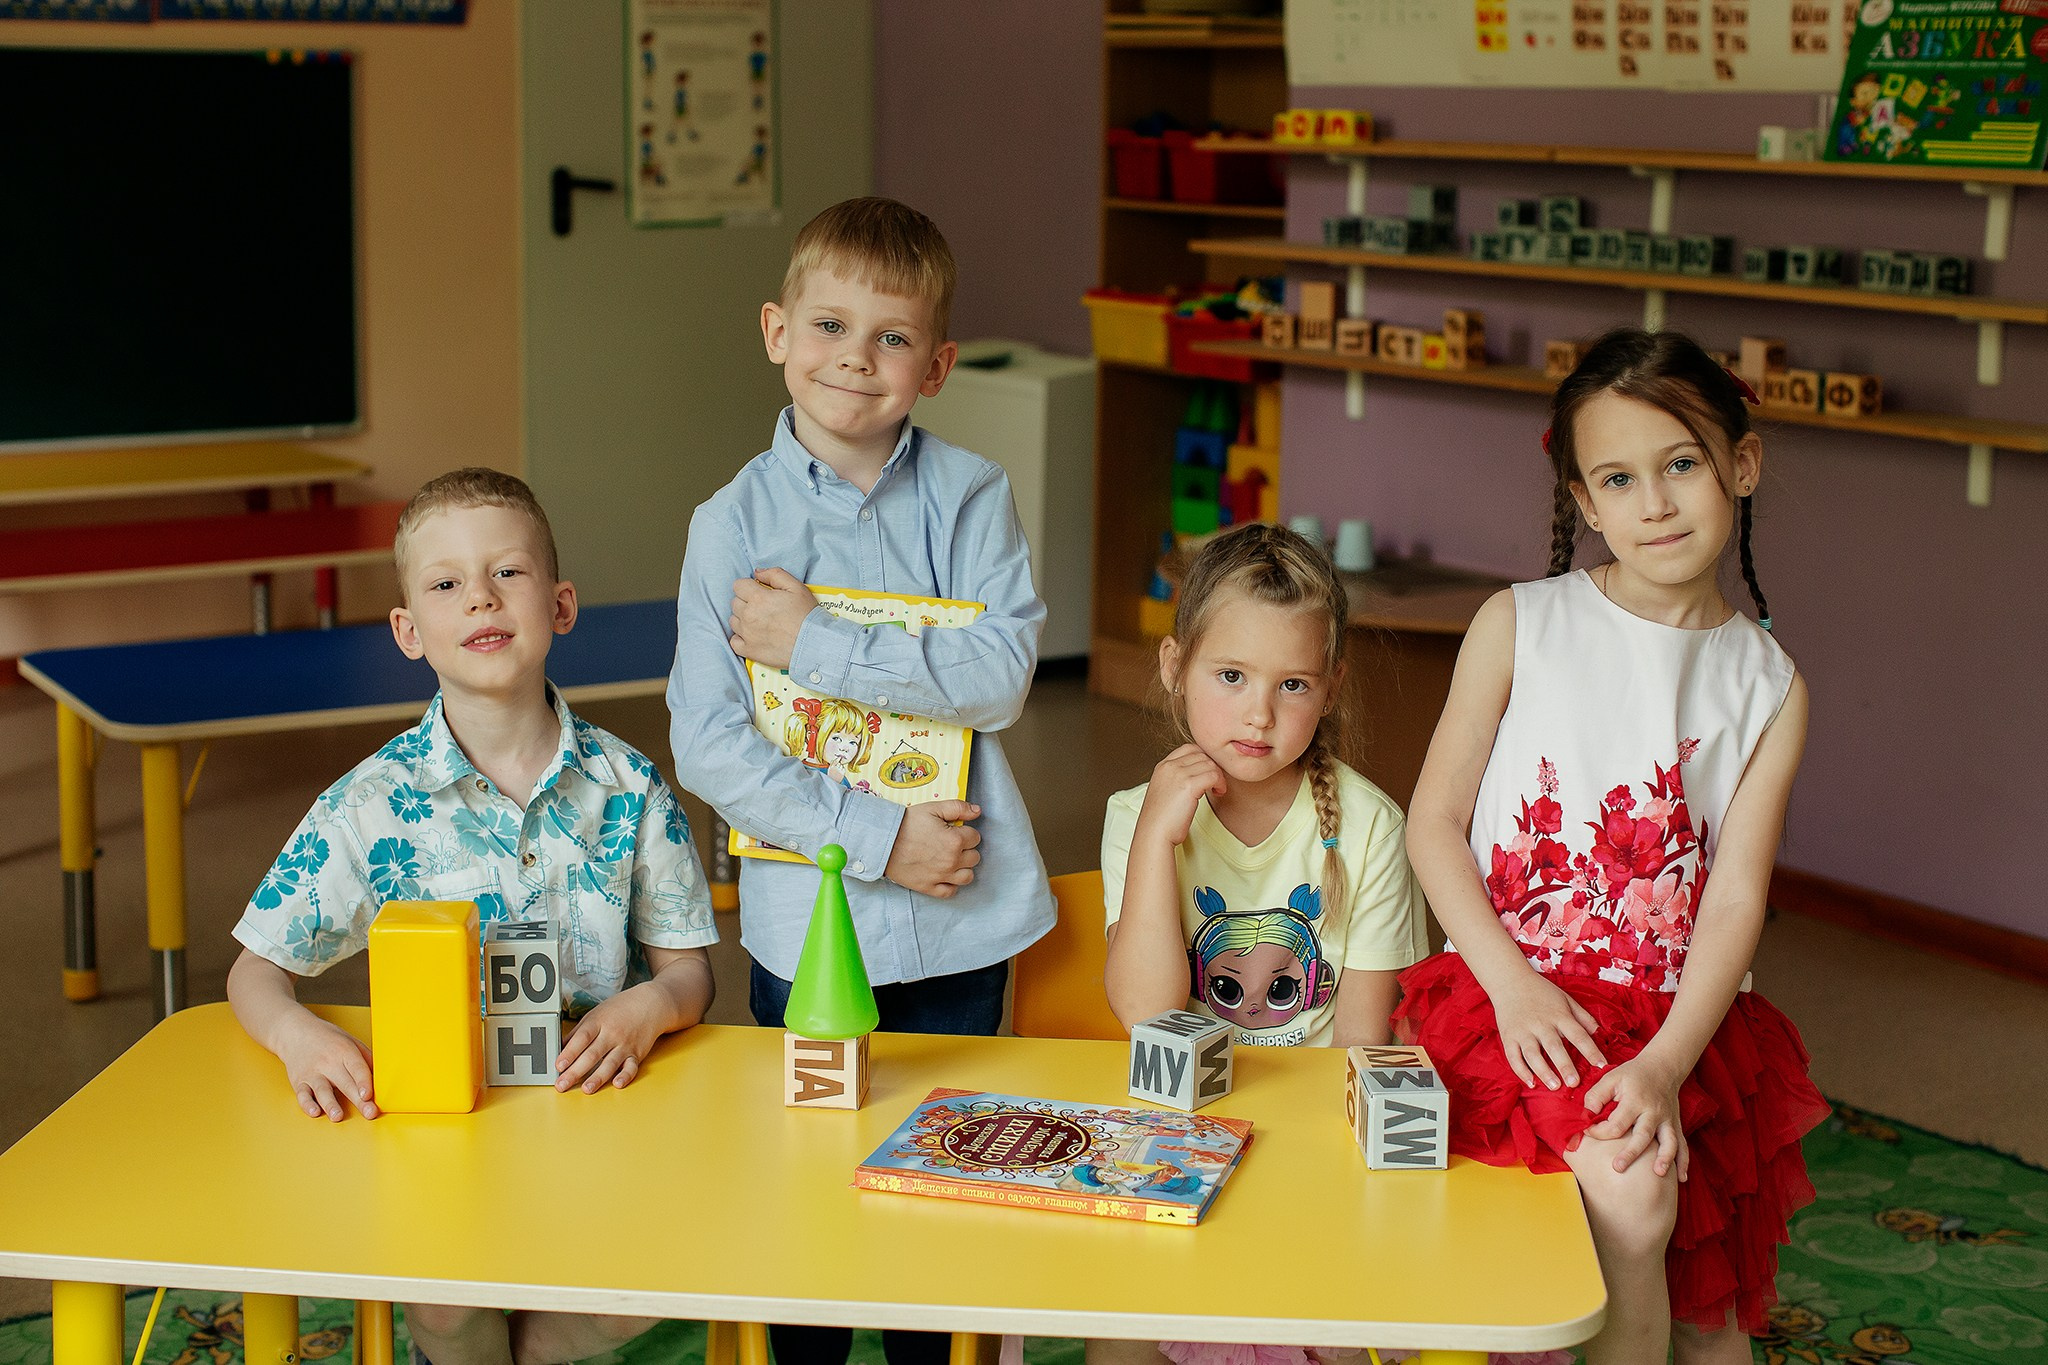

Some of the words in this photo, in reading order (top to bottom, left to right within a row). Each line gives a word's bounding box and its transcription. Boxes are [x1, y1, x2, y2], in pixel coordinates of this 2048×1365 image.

[1889, 15, 2025, 31] МАГНИТНАЯ
[1868, 31, 2027, 59] АЗБУКА
[1828, 385, 1853, 407] Ф
[818, 600, 844, 611] стрид
[844, 603, 885, 618] Линдгрен
[496, 921, 548, 940] БА
[491, 952, 556, 1004] БО
[1147, 1013, 1217, 1037] МО
[1241, 1027, 1306, 1047] SURPRISE!
[498, 1027, 547, 1075] Н
[794, 1040, 844, 1103] ПА
[1132, 1040, 1189, 1098] МУ
[1383, 1099, 1437, 1165] МУ
[912, 1179, 959, 1195] Детские
[962, 1186, 995, 1200] стихи
[998, 1191, 1005, 1201] о
[1007, 1193, 1041, 1206] самом
[1045, 1197, 1088, 1211] главном
